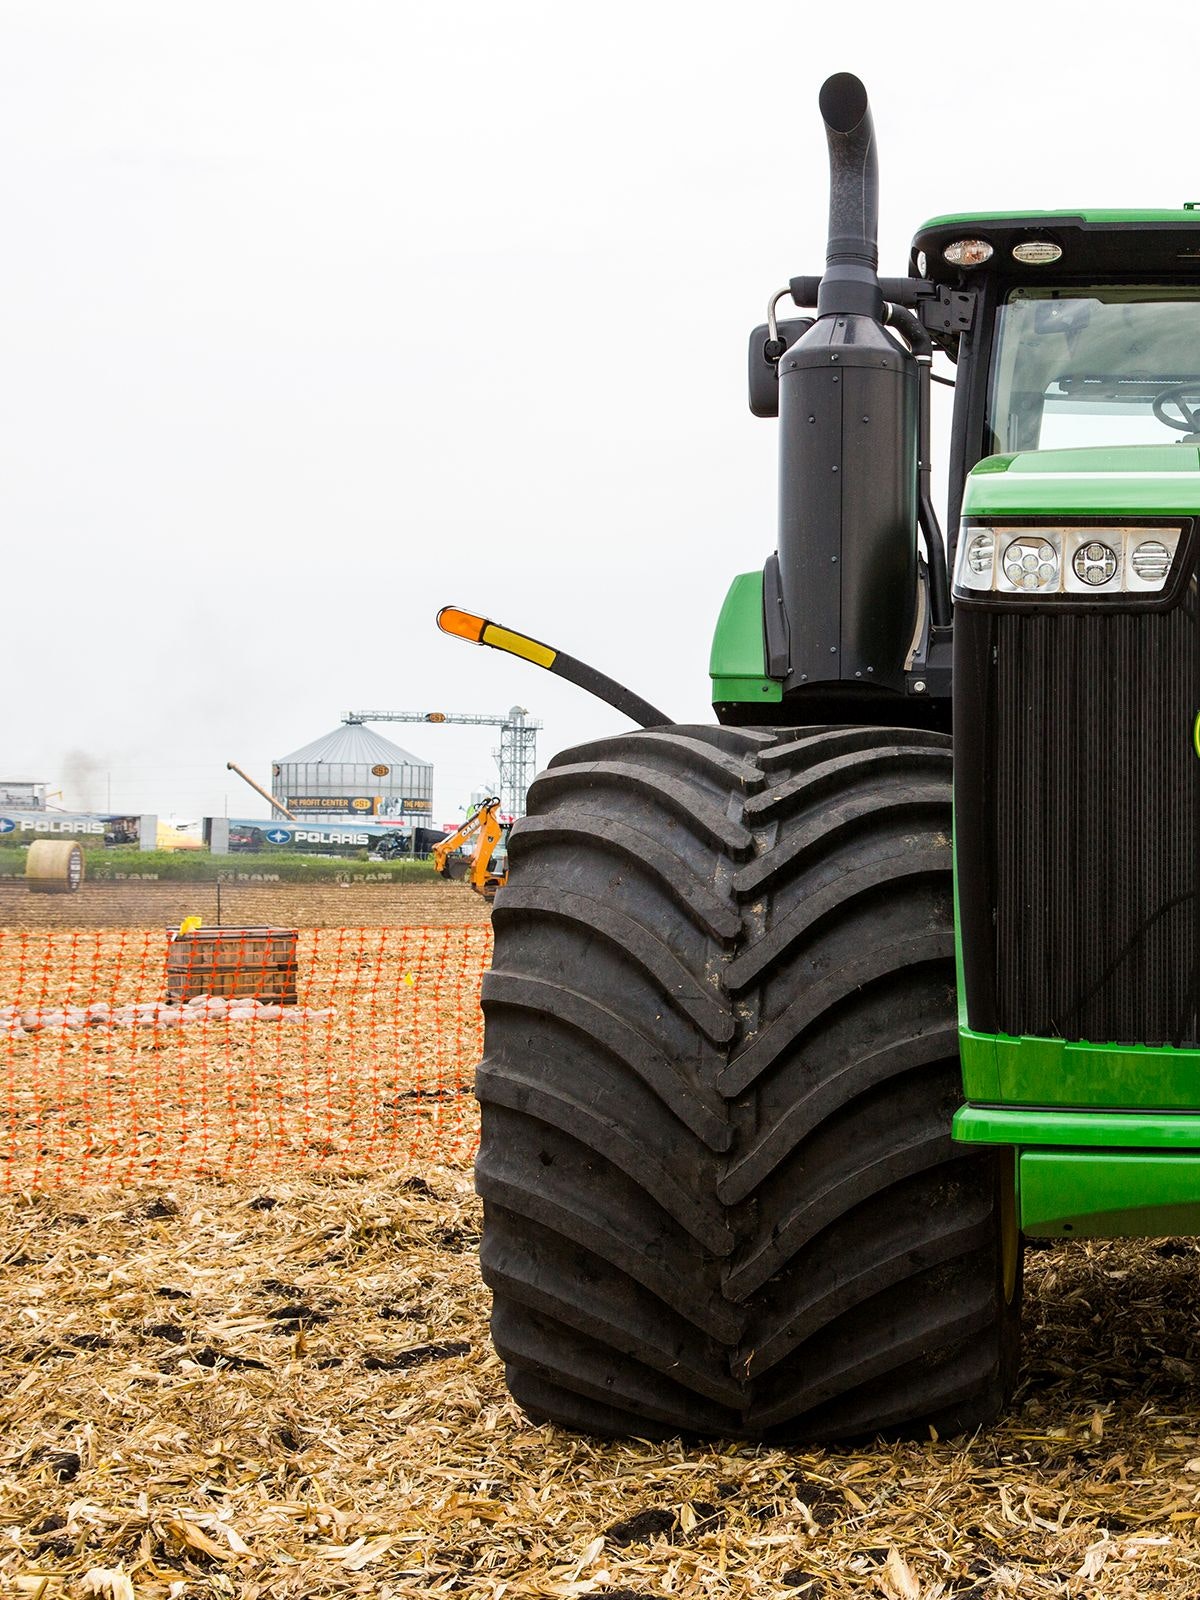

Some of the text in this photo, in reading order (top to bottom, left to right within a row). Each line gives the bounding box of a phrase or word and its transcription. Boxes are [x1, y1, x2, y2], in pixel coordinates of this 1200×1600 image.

[288, 799, 349, 807] THE PROFIT CENTER
[20, 820, 105, 834] POLARIS
[294, 831, 369, 845] POLARIS
[239, 873, 280, 882] RAM
[353, 873, 393, 882] RAM
